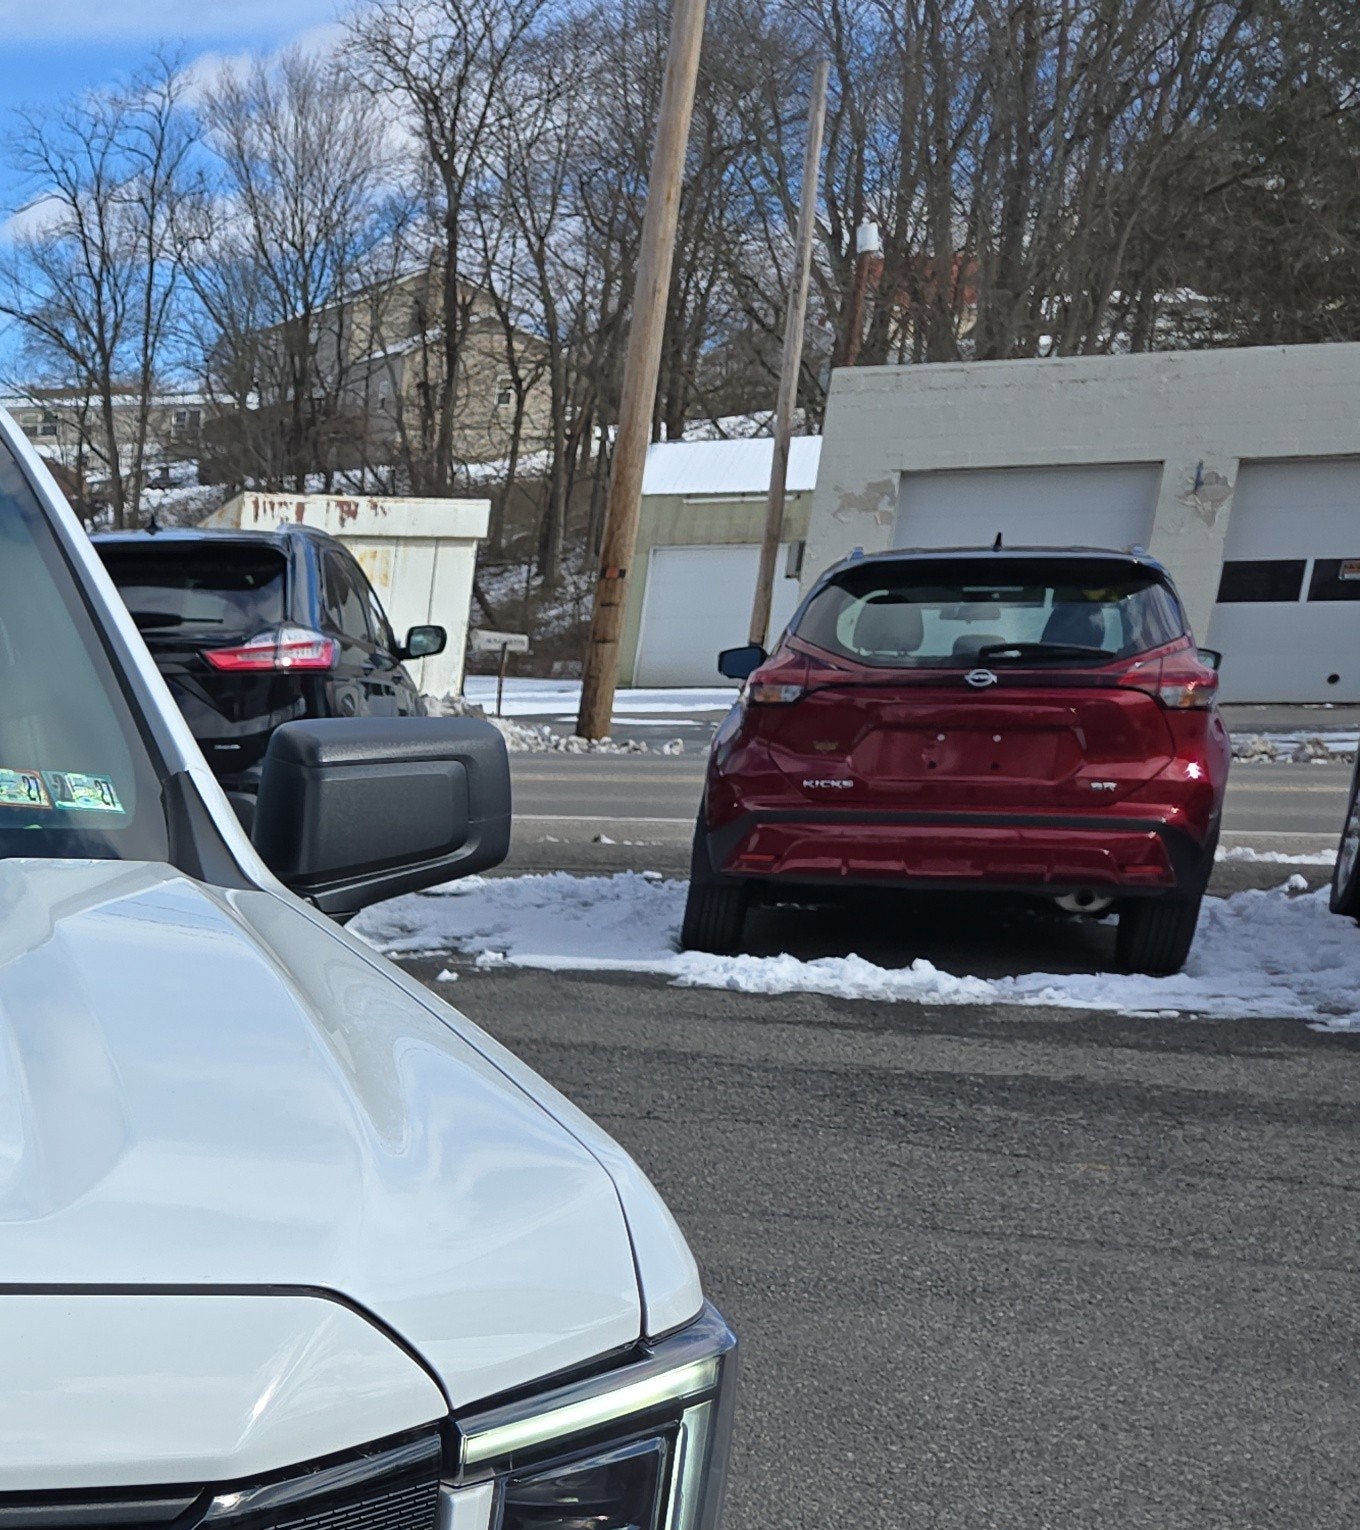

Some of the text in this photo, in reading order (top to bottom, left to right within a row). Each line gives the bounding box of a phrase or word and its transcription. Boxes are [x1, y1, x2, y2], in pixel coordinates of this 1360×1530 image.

[22, 775, 41, 804] 27
[94, 780, 116, 807] 27
[802, 779, 854, 789] KICKS
